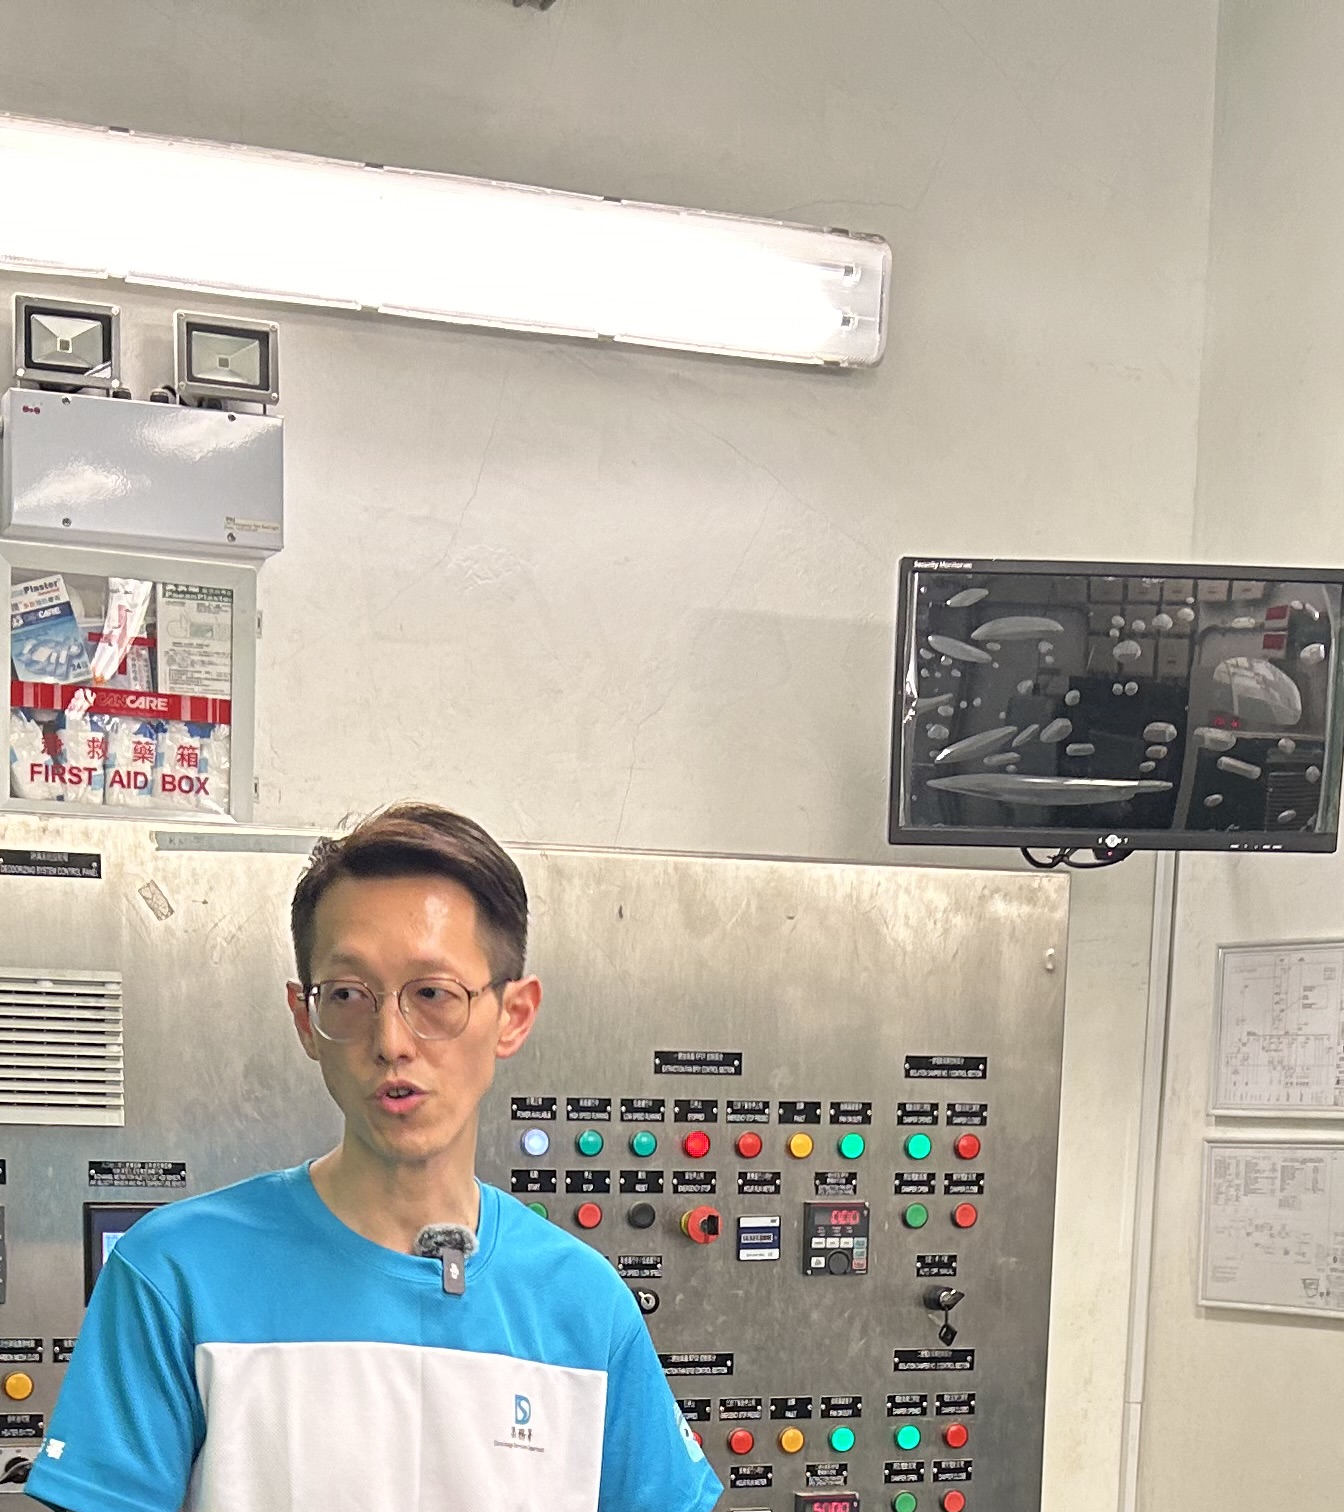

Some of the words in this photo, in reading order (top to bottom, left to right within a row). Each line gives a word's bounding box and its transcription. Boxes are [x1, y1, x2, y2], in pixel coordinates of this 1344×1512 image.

[30, 763, 97, 787] FIRST
[109, 770, 149, 790] AID
[161, 774, 210, 796] BOX
